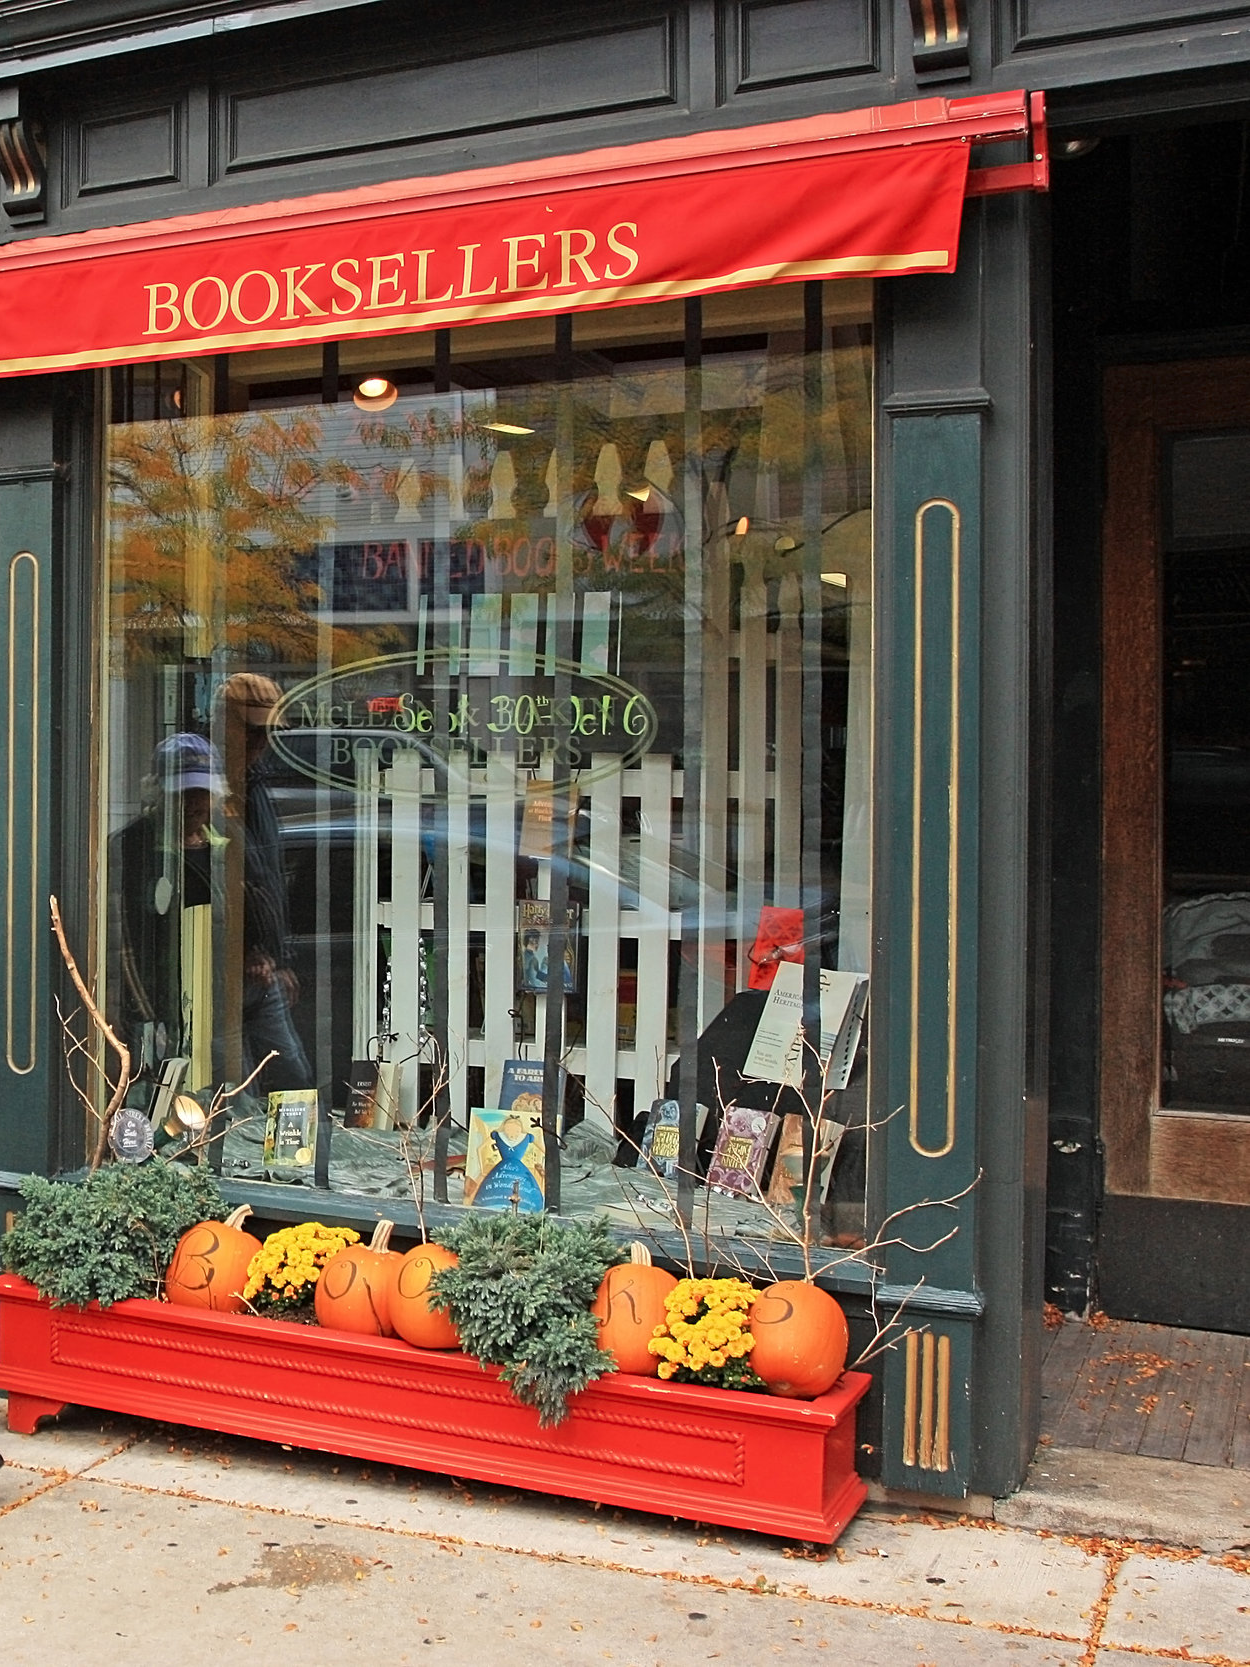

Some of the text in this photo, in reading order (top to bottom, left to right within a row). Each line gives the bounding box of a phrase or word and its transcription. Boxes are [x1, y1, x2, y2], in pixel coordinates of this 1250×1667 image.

[142, 221, 640, 336] BOOKSELLERS
[361, 539, 485, 580] BANED
[494, 536, 594, 578] BOOS
[329, 736, 583, 766] BOOKSELLERS
[522, 902, 547, 918] Harry
[513, 1074, 526, 1082] TO
[127, 1120, 136, 1128] On
[123, 1128, 138, 1137] Sale
[279, 1129, 302, 1137] Wrinkle
[493, 1181, 537, 1194] Wondland
